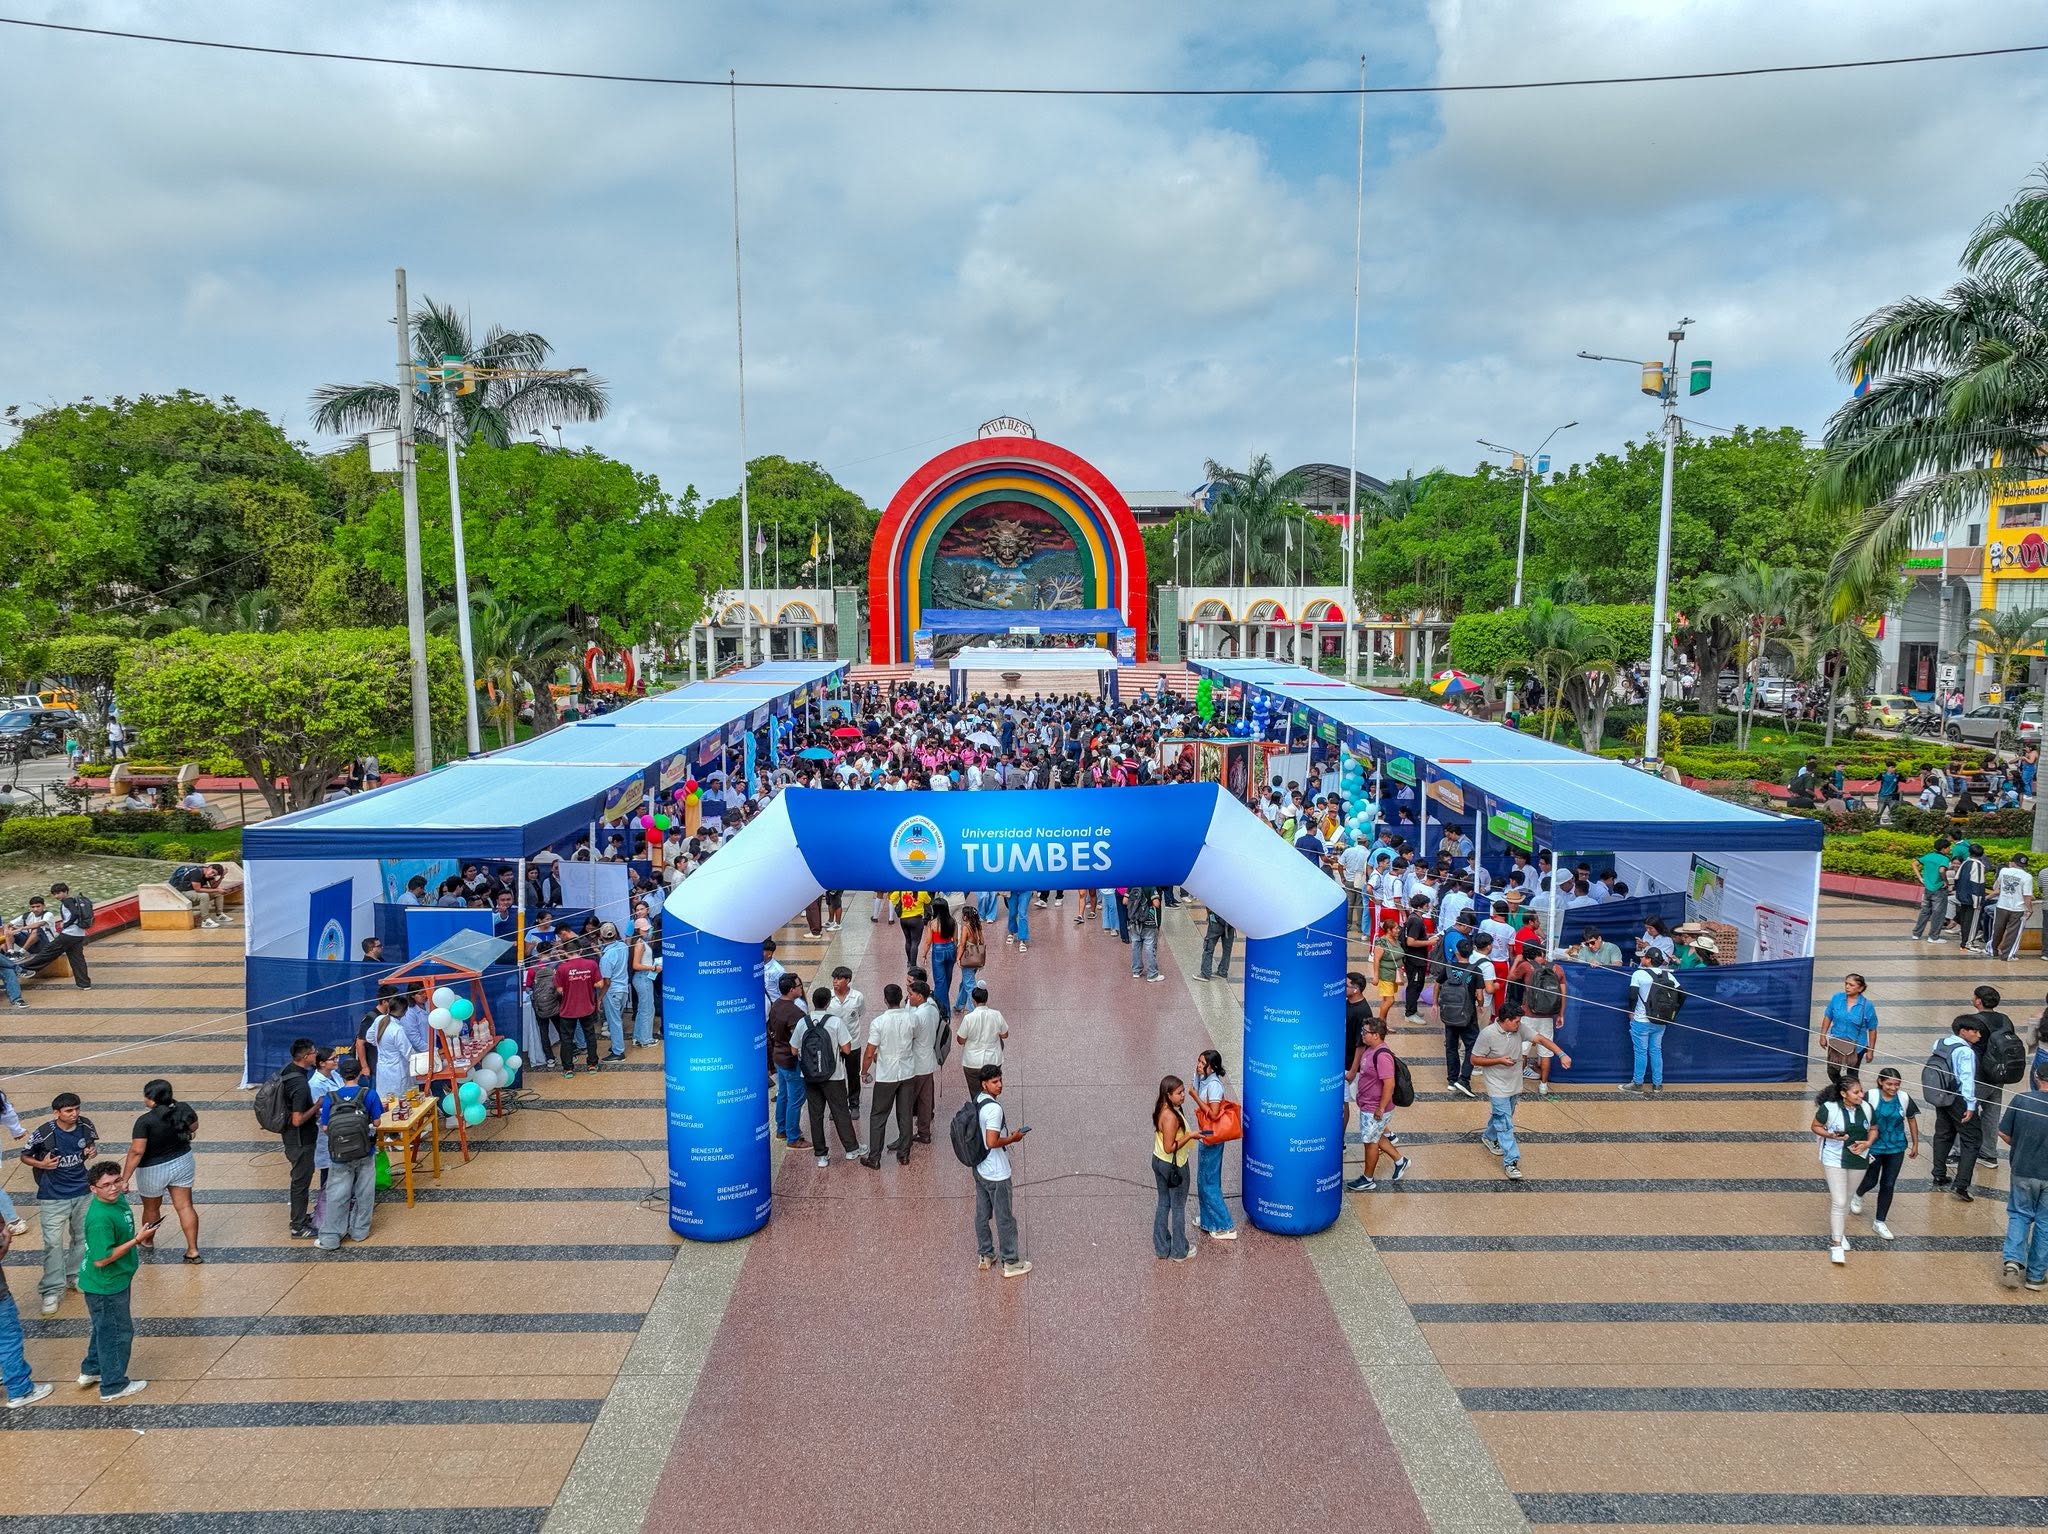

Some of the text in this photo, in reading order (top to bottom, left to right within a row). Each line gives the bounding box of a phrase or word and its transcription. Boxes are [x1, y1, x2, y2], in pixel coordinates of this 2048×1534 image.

[984, 419, 1029, 436] TUMBES
[1945, 668, 1953, 677] E
[961, 826, 1112, 839] Universidad Nacional de
[961, 840, 1112, 873] TUMBES
[1296, 941, 1332, 950] Seguimiento
[1303, 949, 1332, 957] Graduado
[698, 966, 742, 975] UNIVERSITARIO
[716, 998, 748, 1007] BIENESTAR
[716, 1003, 756, 1015] UNIVERSITARIO
[1263, 1005, 1301, 1017] Seguimiento
[1269, 1014, 1300, 1024] Graduado
[1293, 1042, 1330, 1053] Seguimiento
[1299, 1050, 1329, 1059] Graduado
[689, 1063, 734, 1072] UNIVERSITARIO
[717, 1087, 748, 1097] BIENESTAR
[716, 1093, 757, 1105] UNIVERSITARIO
[1260, 1099, 1297, 1111] Seguimiento
[1266, 1108, 1296, 1118] Graduado
[1289, 1137, 1327, 1146] Seguimiento
[1296, 1144, 1326, 1153] Graduado
[690, 1153, 735, 1162] UNIVERSITARIO
[717, 1182, 749, 1194] BIENESTAR
[717, 1188, 758, 1202] UNIVERSITARIO
[1258, 1197, 1294, 1211] Seguimiento
[1263, 1206, 1293, 1219] Graduado
